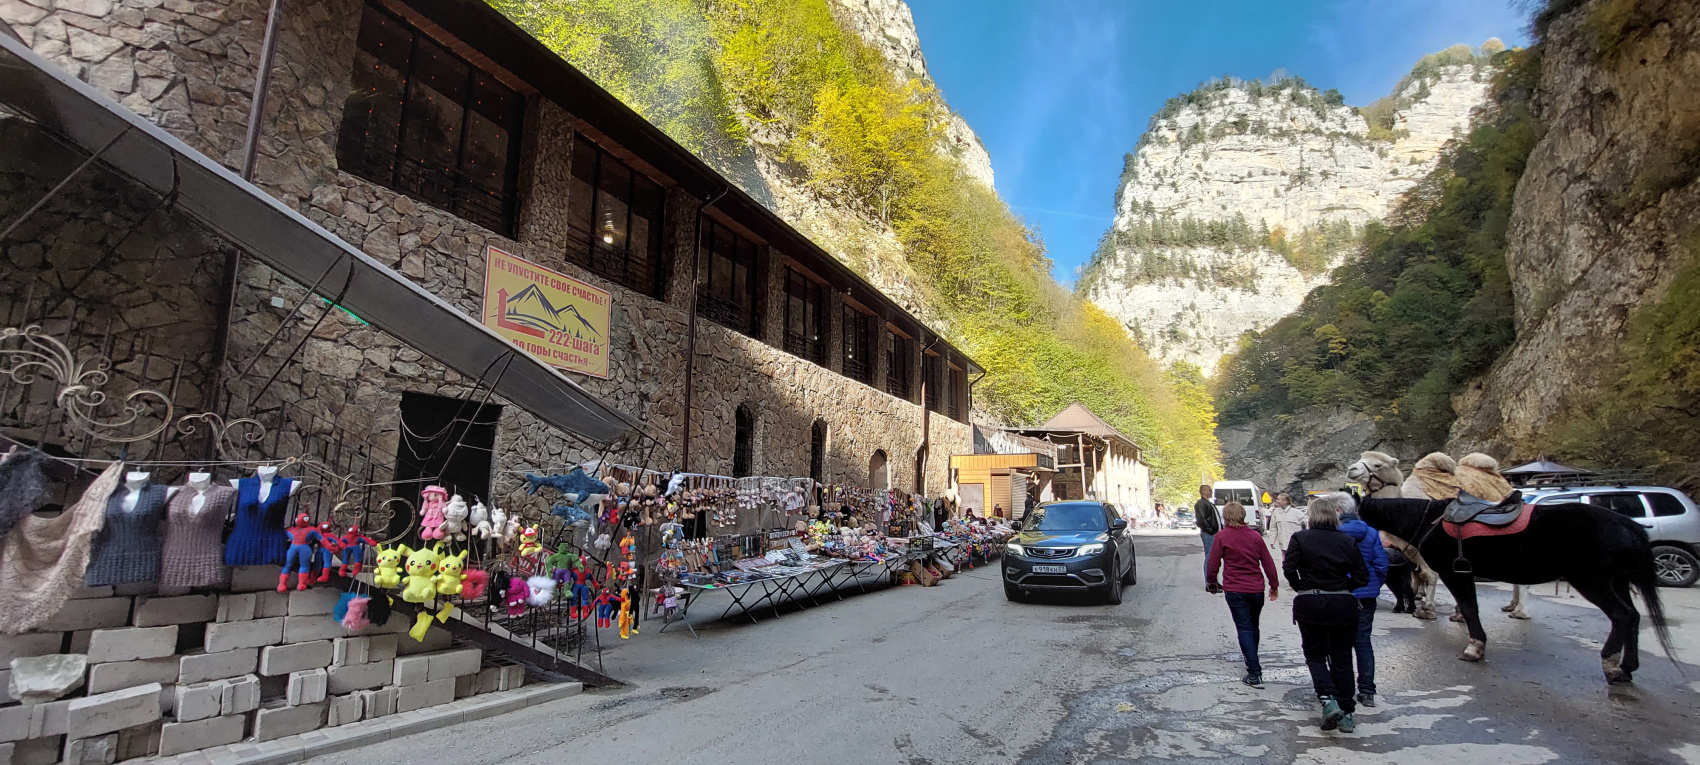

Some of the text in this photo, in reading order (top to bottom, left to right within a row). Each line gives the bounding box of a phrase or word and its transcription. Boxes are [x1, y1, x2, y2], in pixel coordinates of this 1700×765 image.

[494, 257, 506, 270] НЕ
[507, 262, 549, 286] УПУСТИТЕ
[550, 278, 571, 293] СВОЕ
[526, 342, 551, 357] горы
[548, 328, 600, 356] 222 шага
